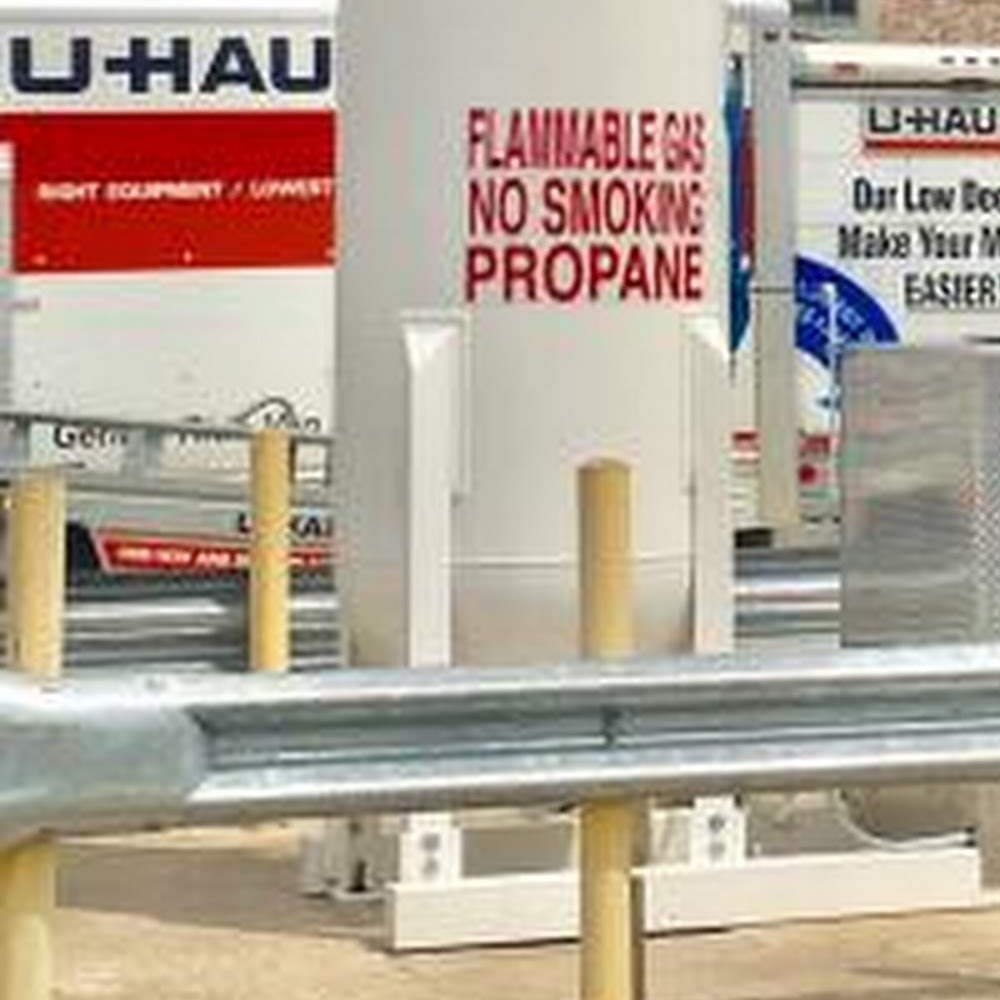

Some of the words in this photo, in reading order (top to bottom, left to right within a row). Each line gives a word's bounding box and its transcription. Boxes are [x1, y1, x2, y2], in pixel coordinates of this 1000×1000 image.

[9, 36, 332, 94] U-HAU
[468, 106, 656, 170] FLAMMABLE
[663, 110, 704, 173] GAS
[468, 179, 528, 236] NO
[542, 177, 703, 236] SMOKING
[853, 176, 896, 213] Our
[904, 176, 955, 213] Low
[839, 225, 911, 261] Make
[918, 226, 972, 261] Your
[466, 243, 703, 303] PROPANE
